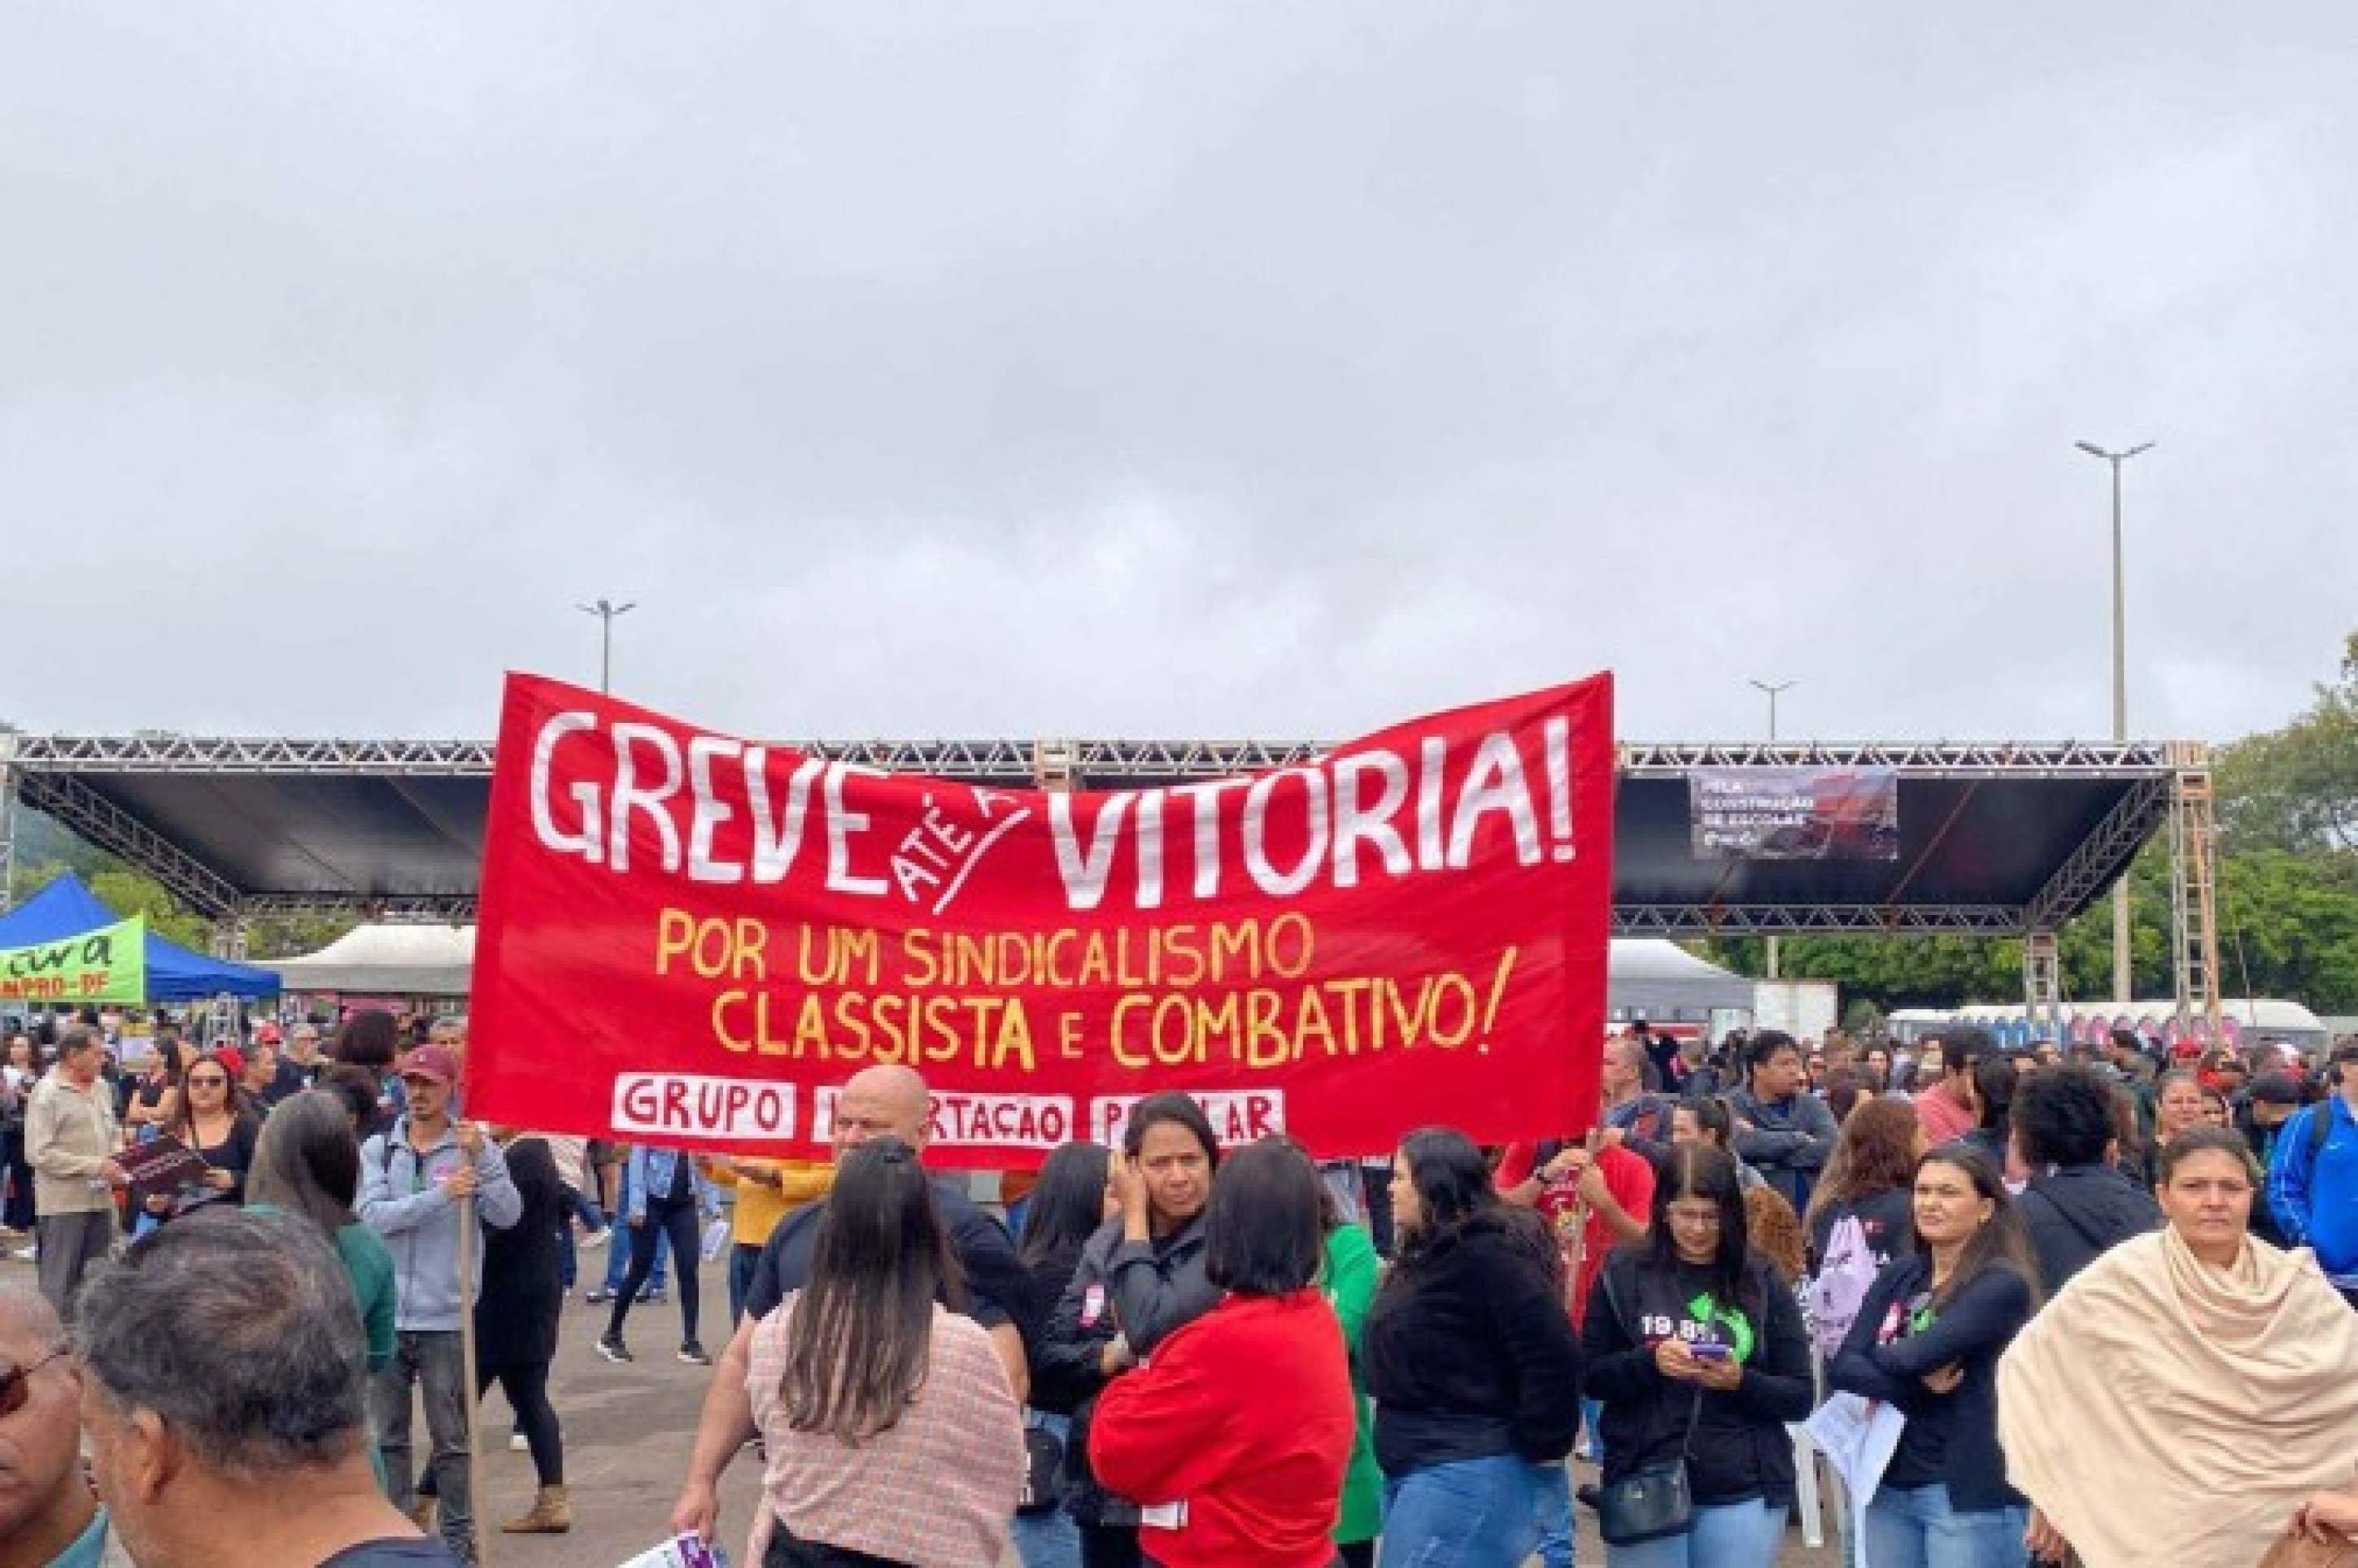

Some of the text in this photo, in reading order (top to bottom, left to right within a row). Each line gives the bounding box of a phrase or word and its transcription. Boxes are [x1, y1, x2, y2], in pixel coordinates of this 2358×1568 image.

[530, 712, 888, 895] GREVE
[891, 793, 974, 904] ATÉ
[1047, 716, 1576, 909] VITORIA!
[656, 908, 1314, 987] POR UM SINDICALISMO
[713, 991, 1034, 1069] CLASSISTA
[1111, 946, 1518, 1069] COMBATIVO!
[622, 1079, 781, 1131] GRUPO
